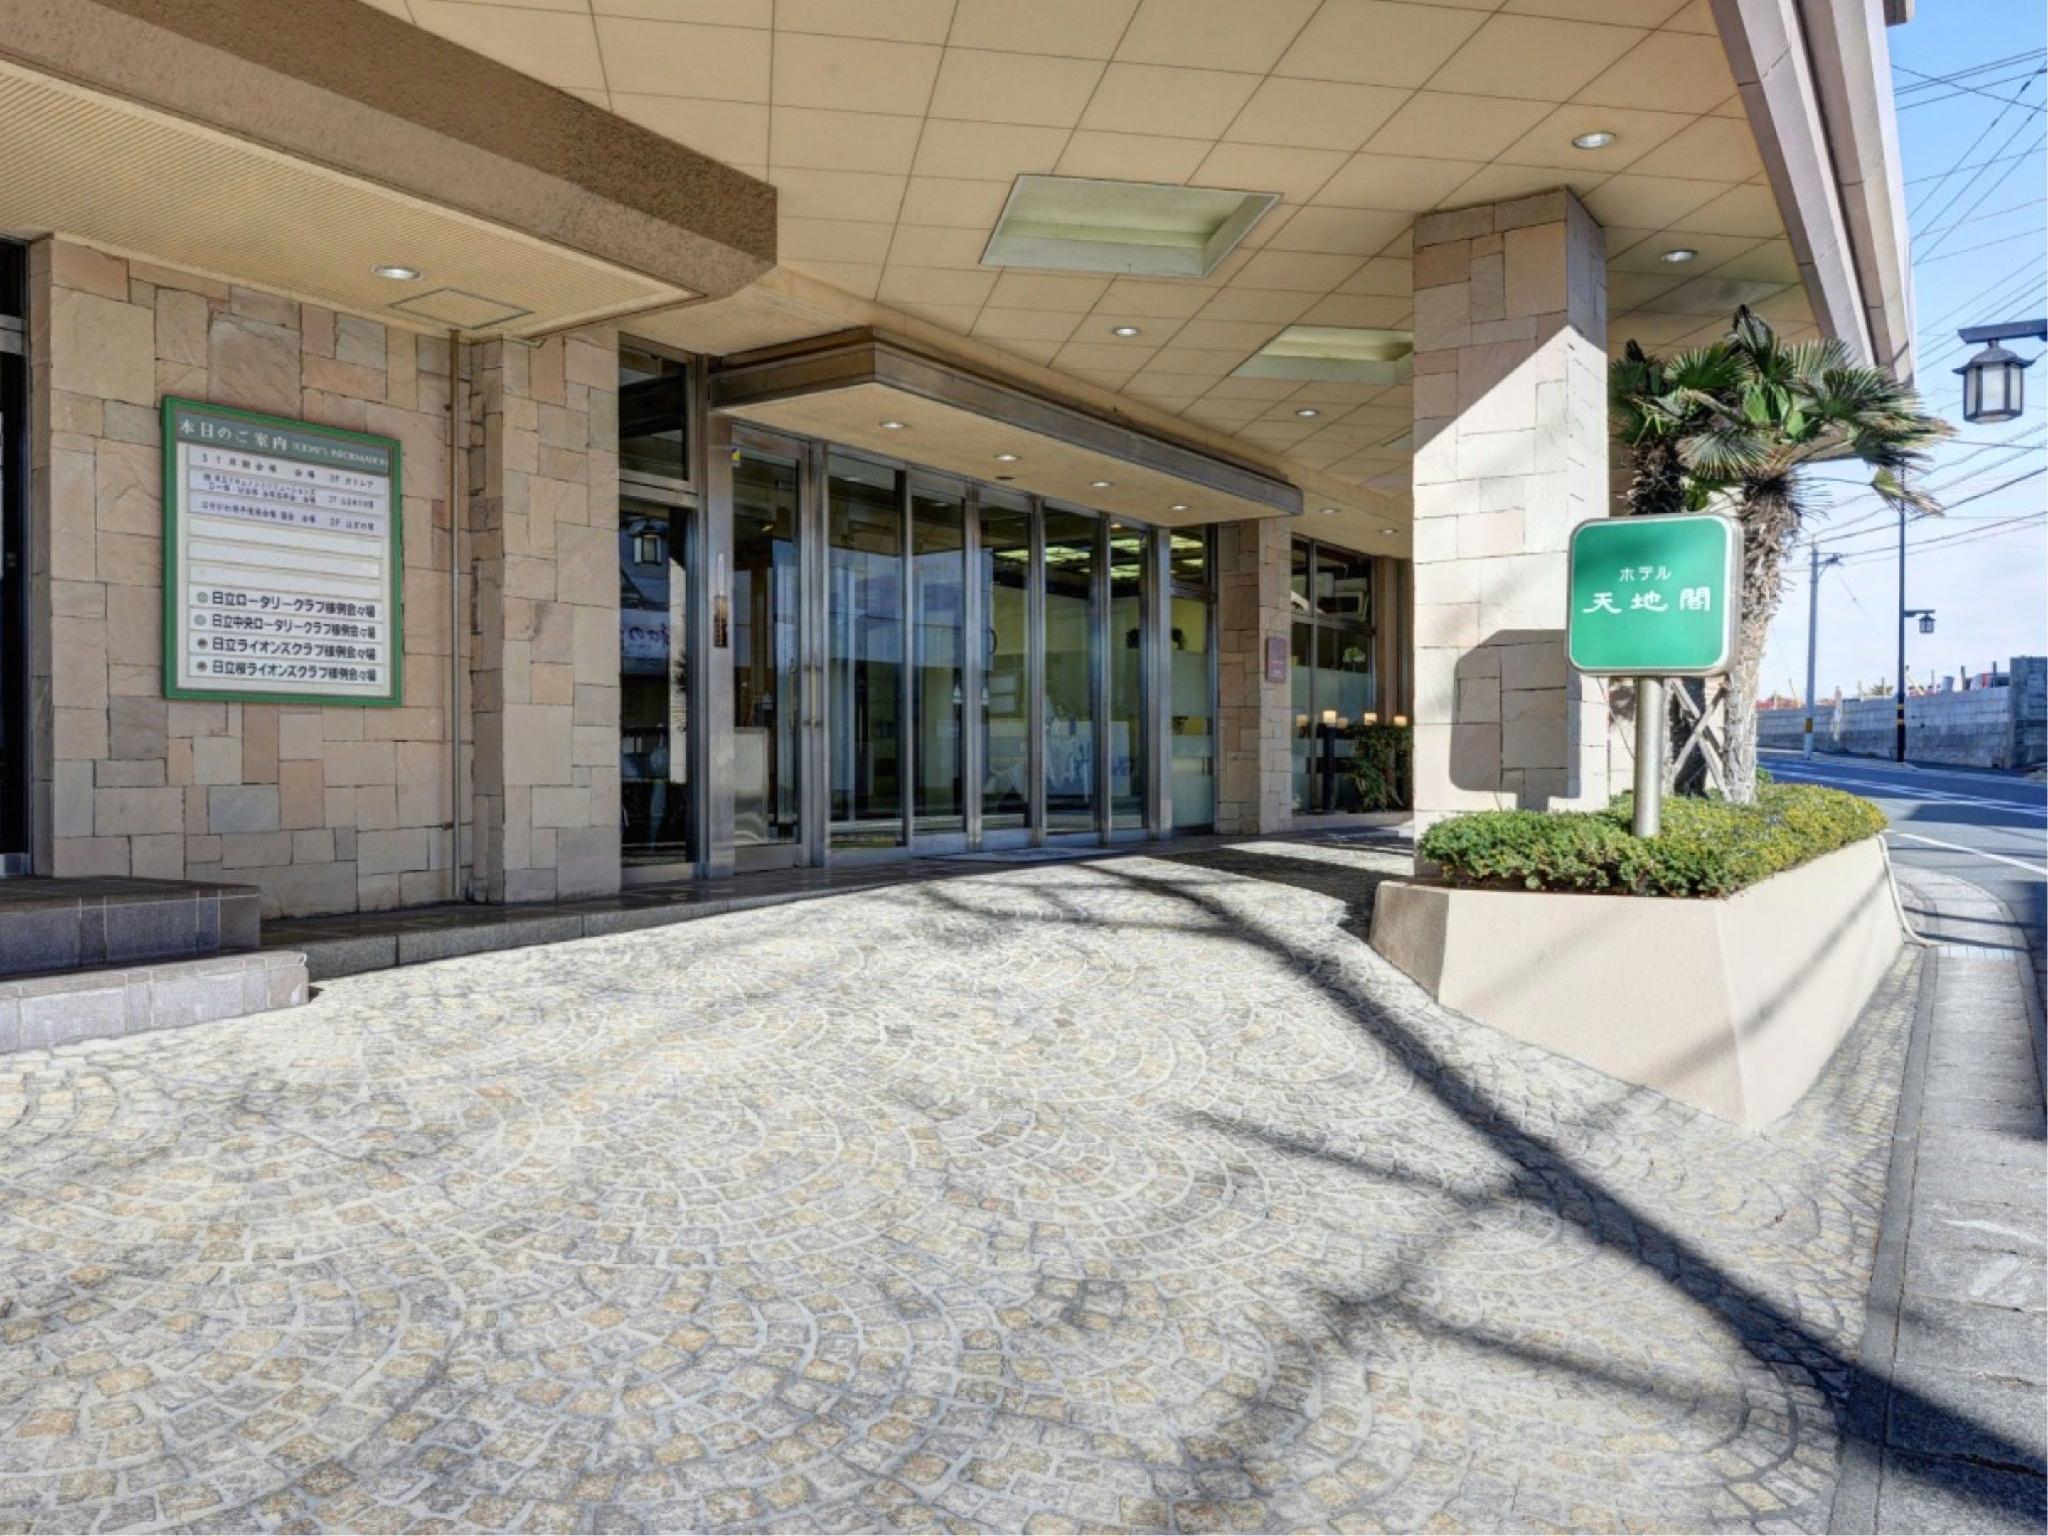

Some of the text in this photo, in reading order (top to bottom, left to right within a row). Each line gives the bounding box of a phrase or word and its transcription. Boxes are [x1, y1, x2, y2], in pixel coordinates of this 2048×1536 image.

[179, 418, 289, 451] 本日のご案内
[1619, 565, 1672, 582] ホテル
[1582, 586, 1711, 615] 天地閣
